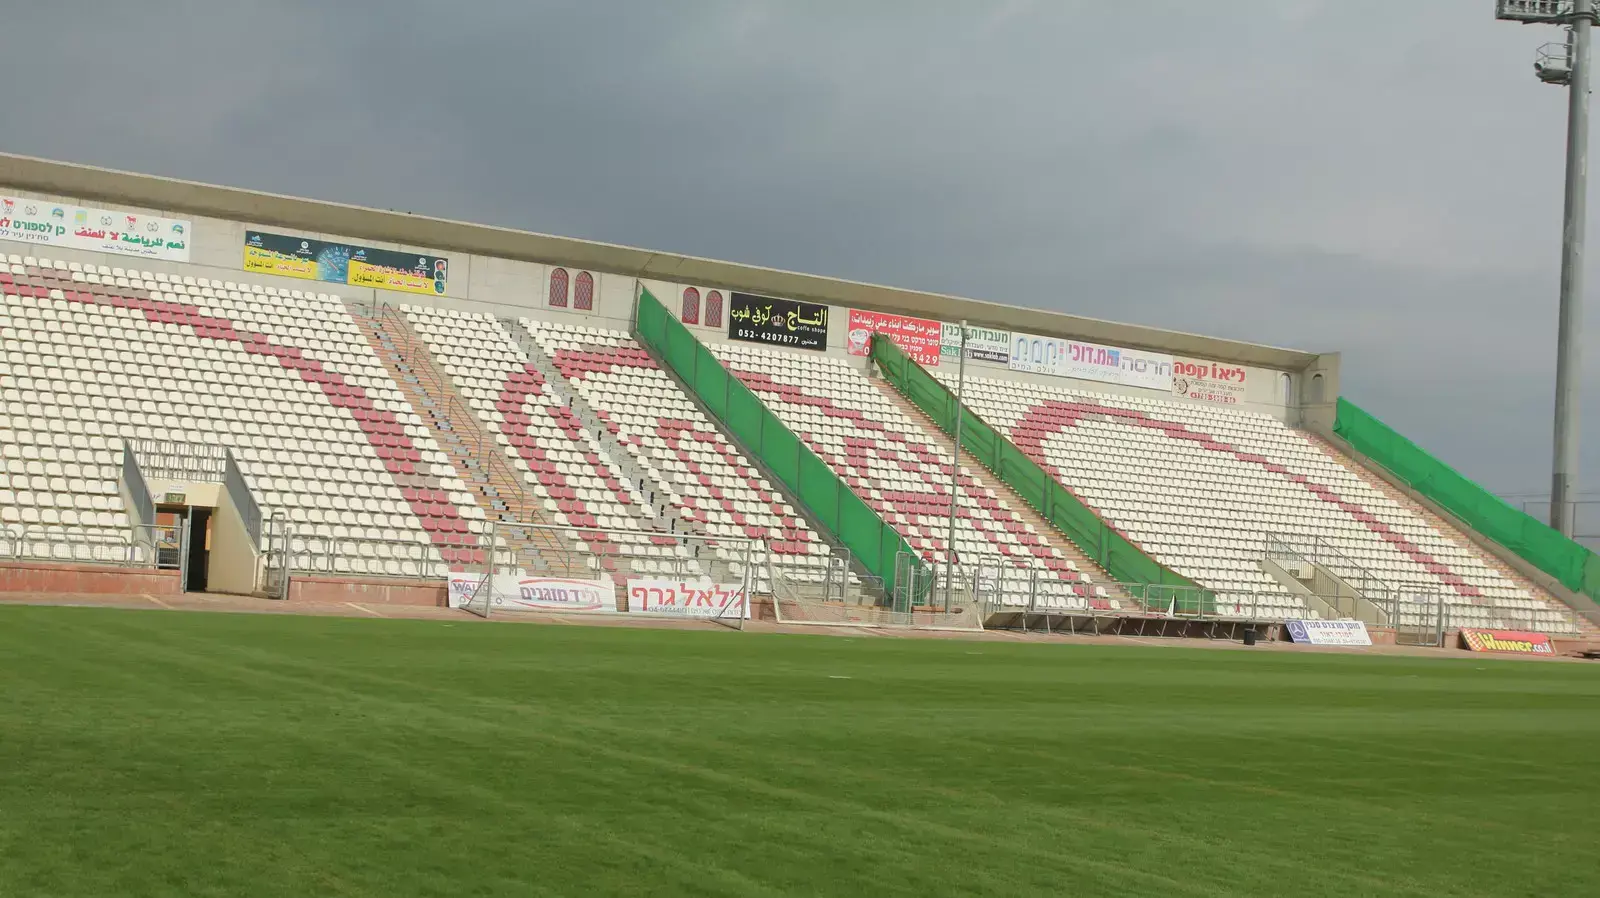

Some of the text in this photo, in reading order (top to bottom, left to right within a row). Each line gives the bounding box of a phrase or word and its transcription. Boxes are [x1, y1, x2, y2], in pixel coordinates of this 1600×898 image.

[13, 219, 53, 233] לספורט
[55, 225, 66, 236] כן
[74, 227, 185, 250] نعم للرياضة لا للعنف
[731, 304, 827, 331] التاج كوفي شوب
[902, 321, 925, 333] ماركت
[942, 324, 1008, 343] מעבדות כנין
[1121, 356, 1172, 377] חרסה
[1174, 361, 1208, 379] קפה
[631, 587, 676, 611] גרף
